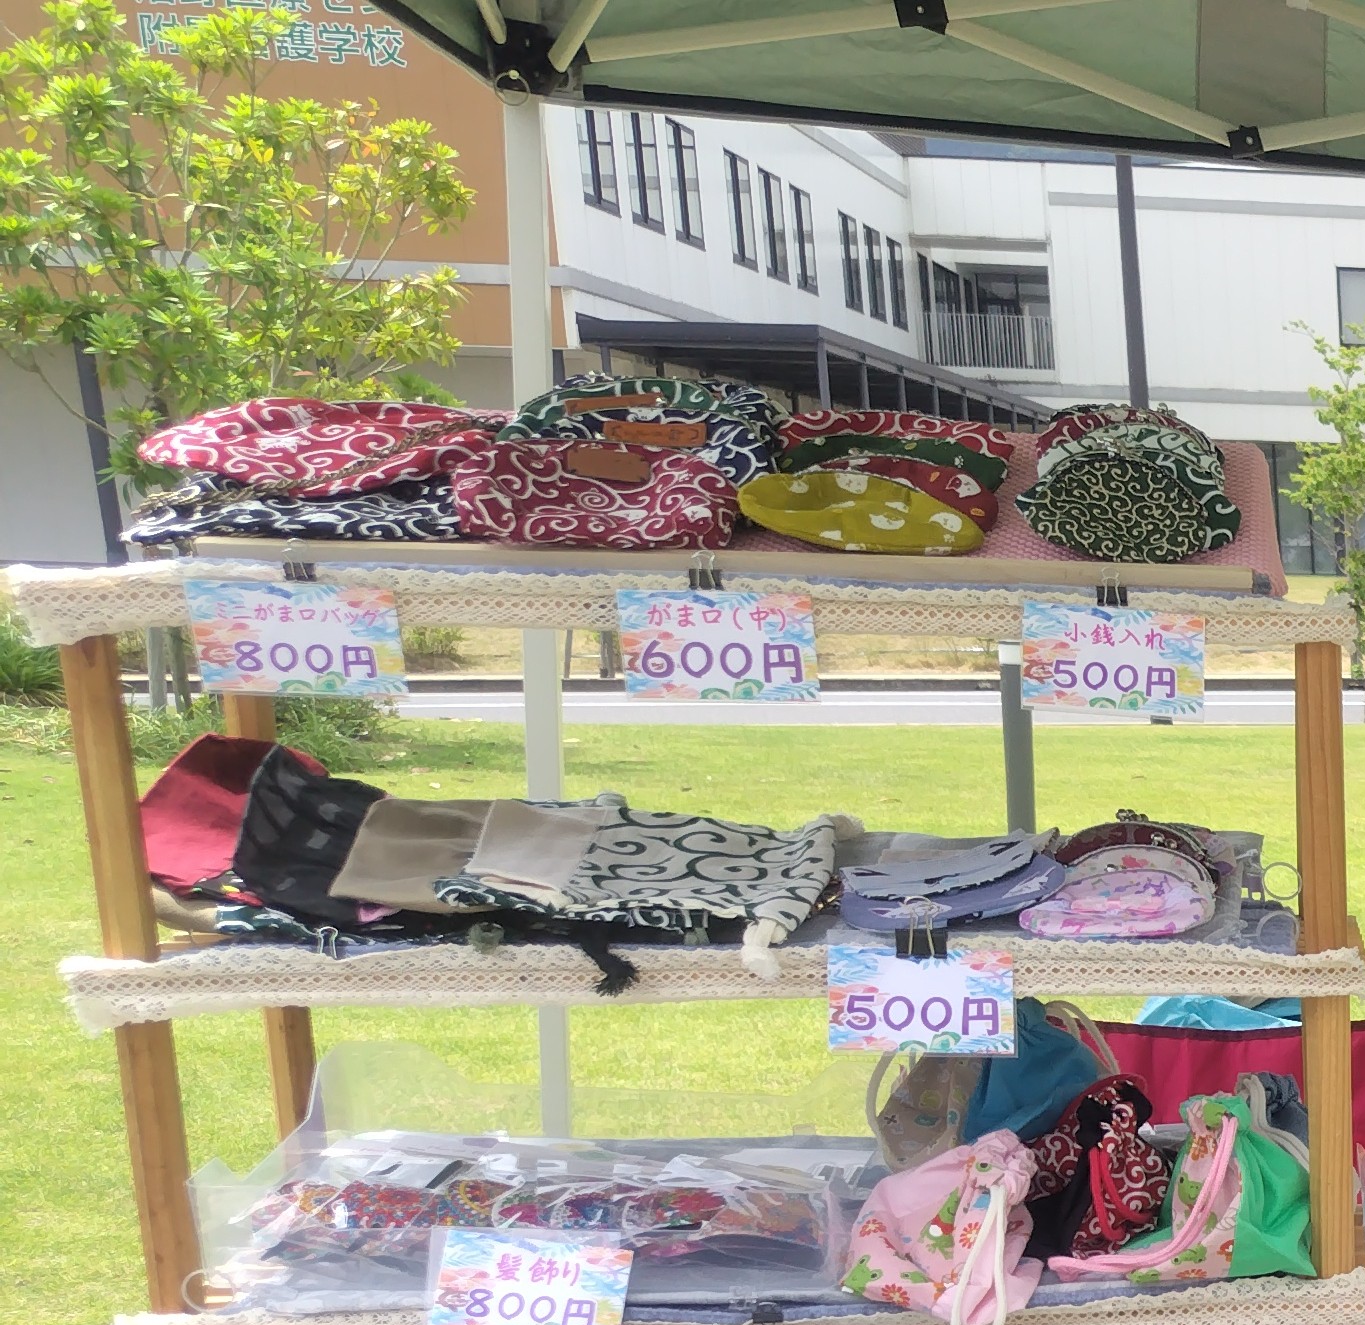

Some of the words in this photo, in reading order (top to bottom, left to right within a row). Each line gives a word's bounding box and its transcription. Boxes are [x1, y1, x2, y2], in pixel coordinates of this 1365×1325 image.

[137, 12, 407, 67] 附護学校
[215, 602, 380, 627] ミニがま口バッグ
[1064, 623, 1165, 650] 小銭入れ
[234, 640, 377, 678] 800円
[641, 640, 803, 683] 600円
[1053, 660, 1177, 698] 500円
[845, 995, 999, 1036] 500円
[496, 1253, 580, 1286] 髪飾り
